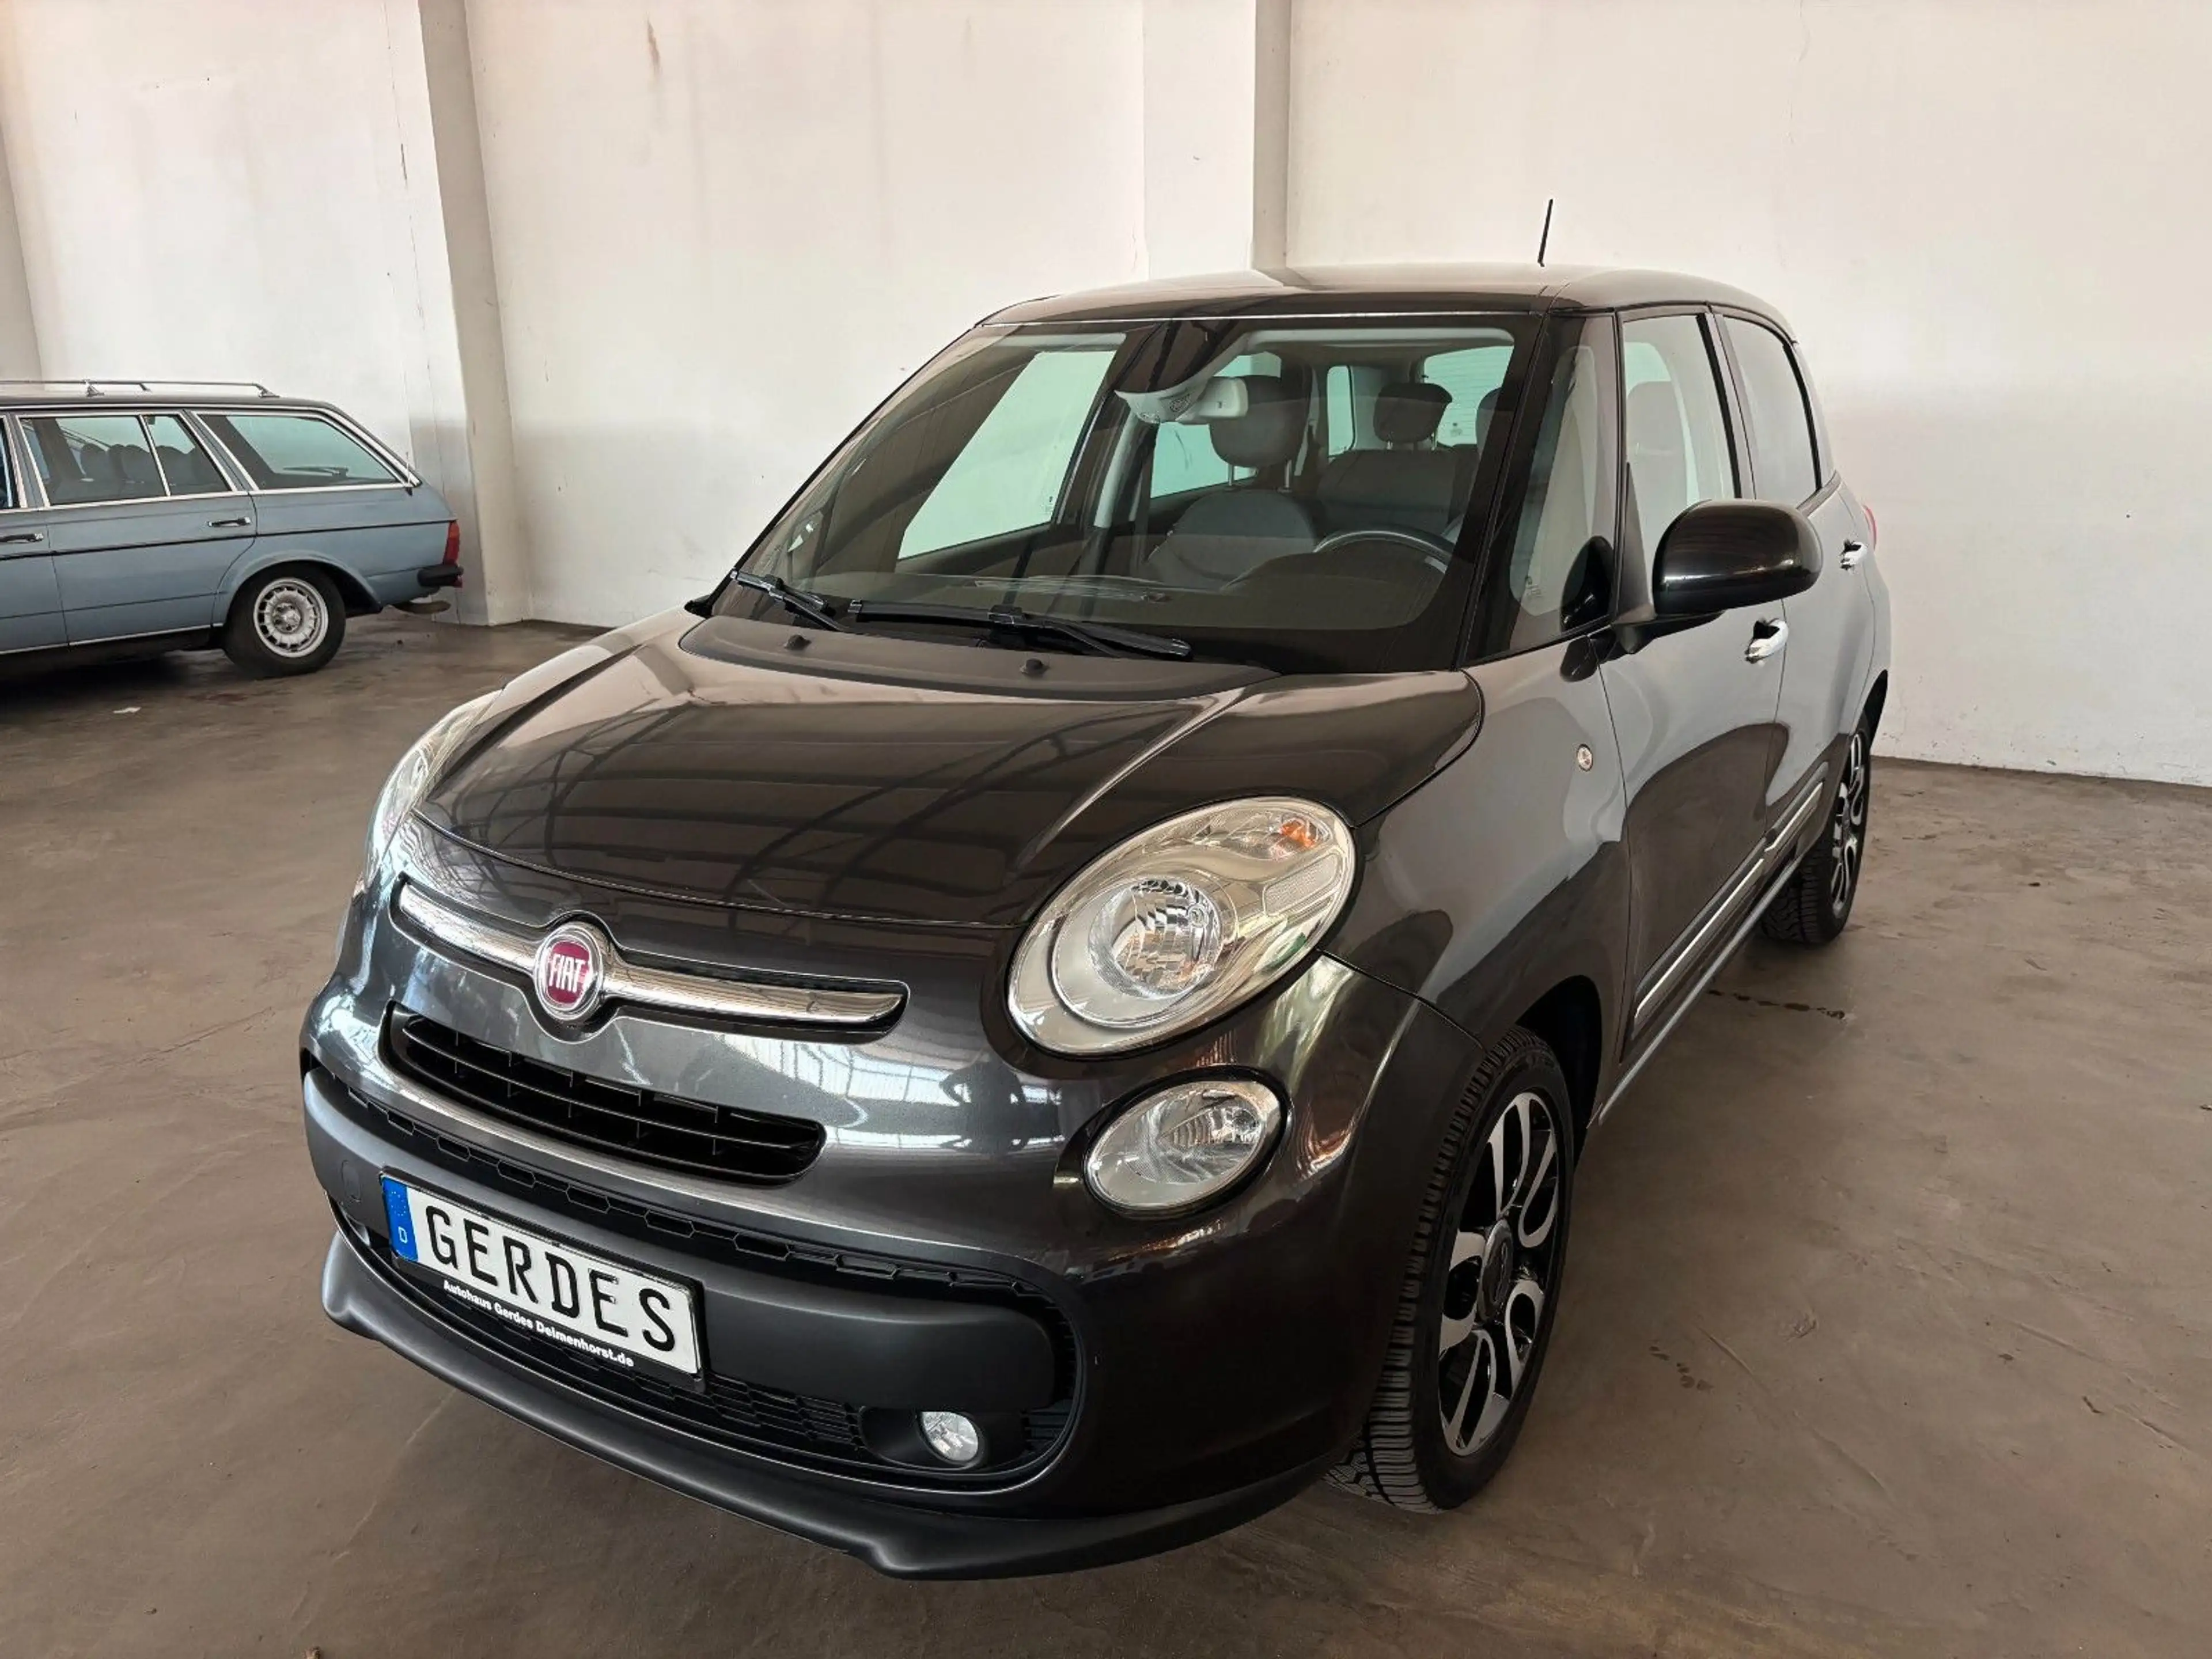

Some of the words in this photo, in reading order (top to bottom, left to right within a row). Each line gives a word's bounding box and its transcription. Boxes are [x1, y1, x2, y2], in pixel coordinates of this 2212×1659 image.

[549, 953, 586, 993] FIAT
[397, 1226, 408, 1244] D
[425, 1205, 676, 1351] GERDES
[444, 1280, 492, 1310] Autohaus
[494, 1302, 533, 1329] Gerdes
[536, 1320, 634, 1367] Delmenhorst.de
